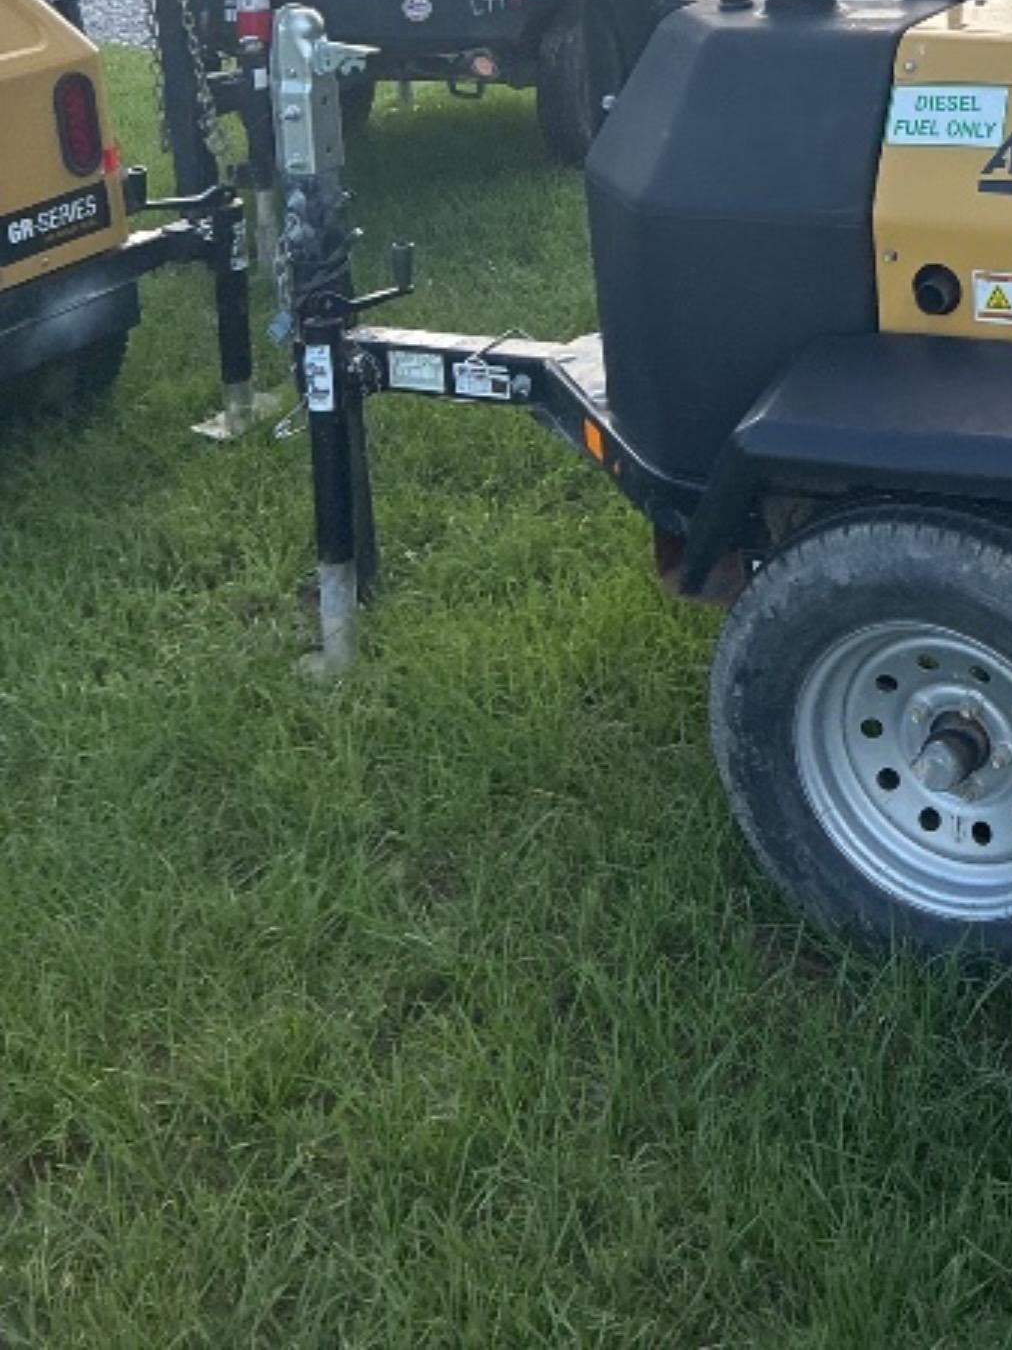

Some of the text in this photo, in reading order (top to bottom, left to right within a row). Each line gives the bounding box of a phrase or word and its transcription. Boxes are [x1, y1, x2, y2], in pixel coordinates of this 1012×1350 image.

[914, 95, 981, 112] DIESEL
[893, 120, 998, 139] FUEL ONLY
